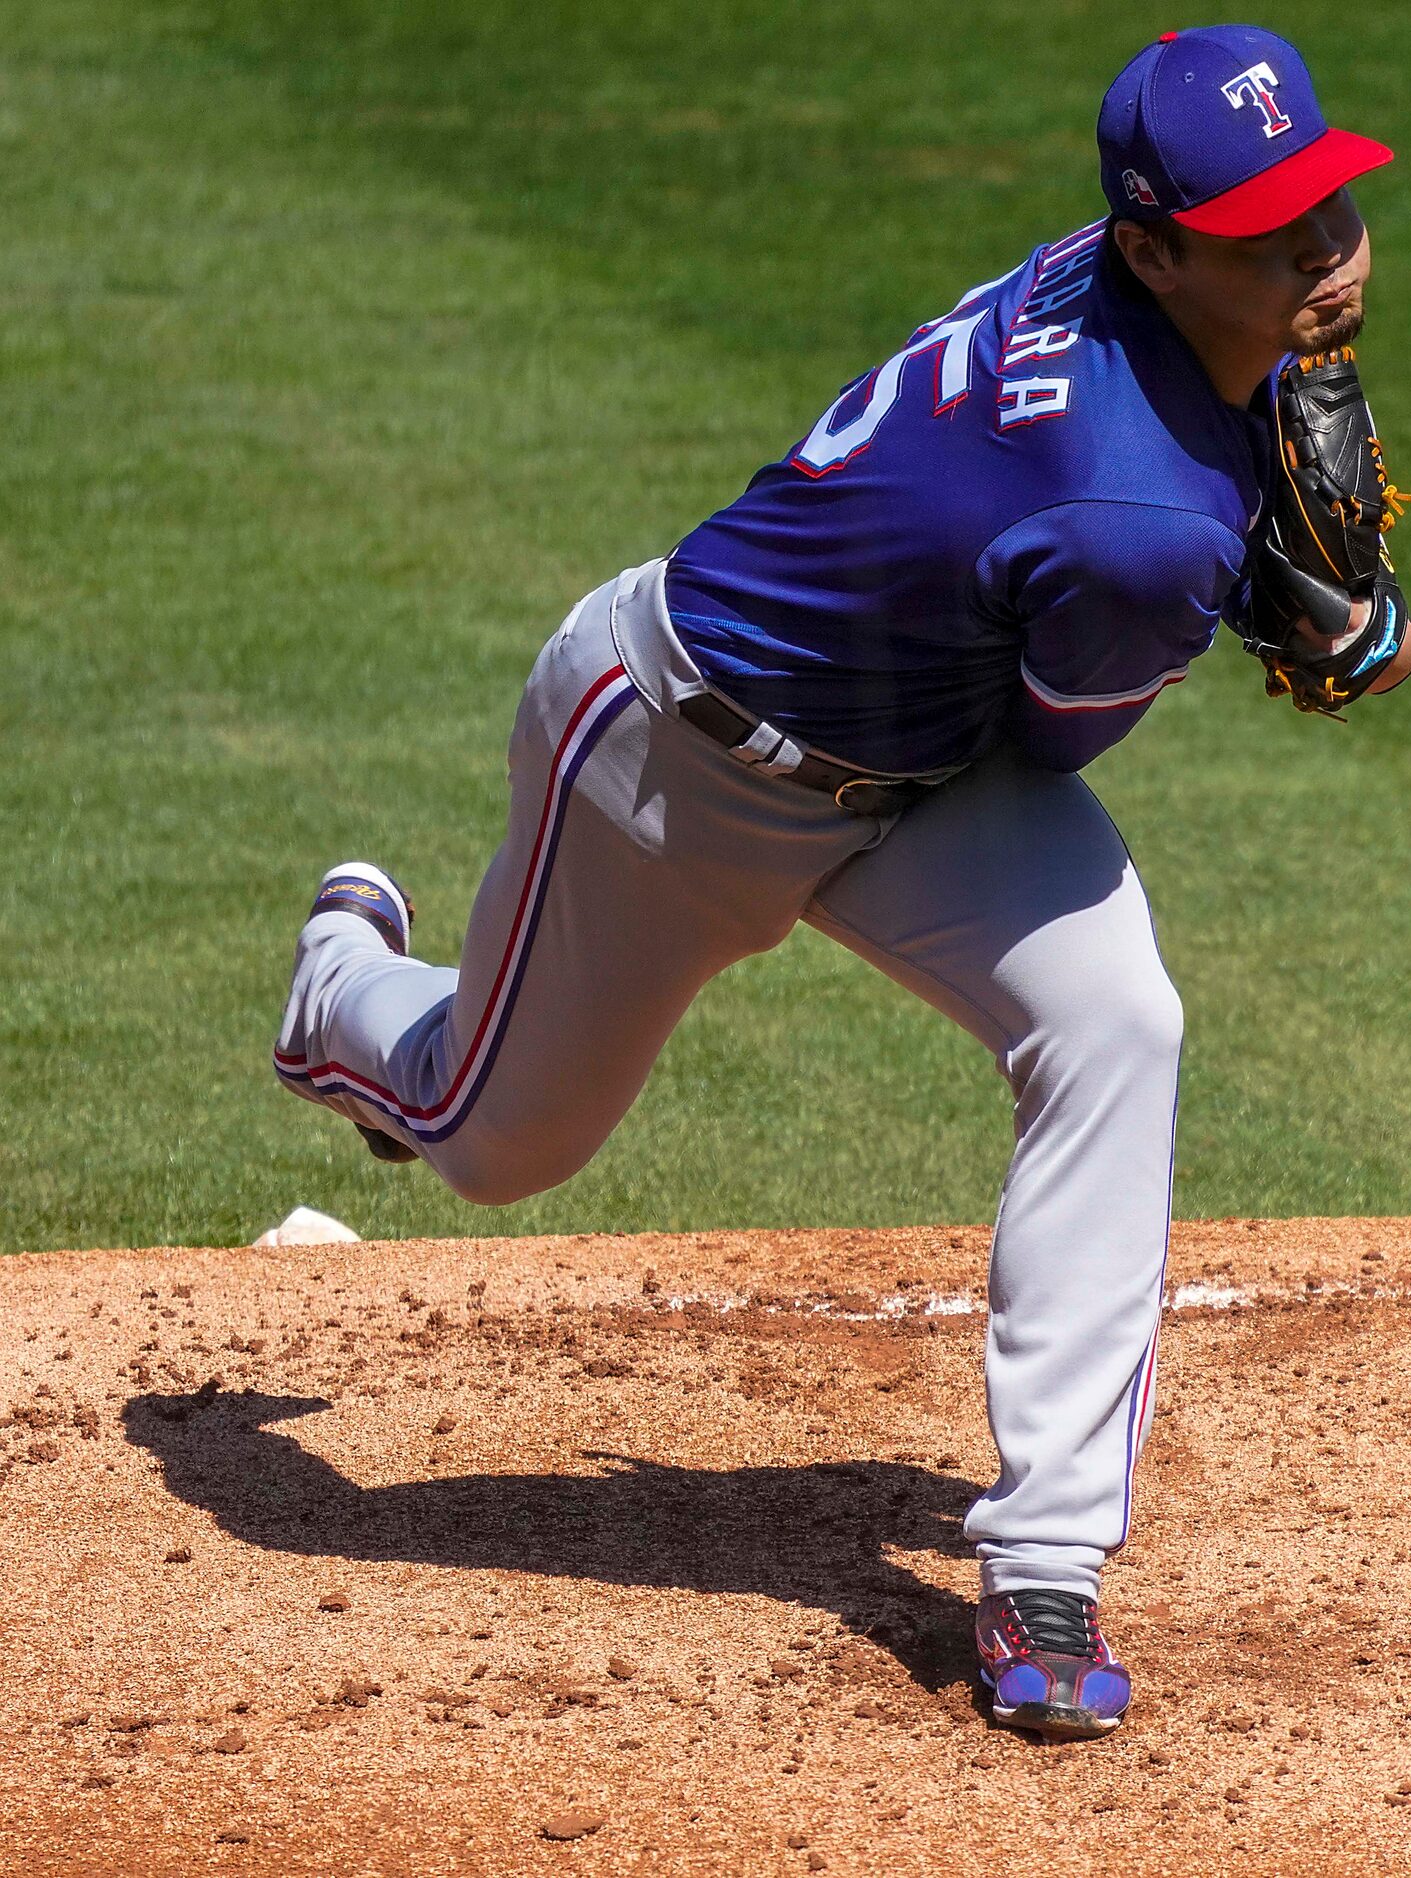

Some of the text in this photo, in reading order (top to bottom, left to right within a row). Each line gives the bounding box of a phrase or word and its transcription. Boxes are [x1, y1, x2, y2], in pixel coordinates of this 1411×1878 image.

[1220, 61, 1293, 139] T
[791, 257, 1029, 478] 5
[997, 218, 1107, 432] IHARA
